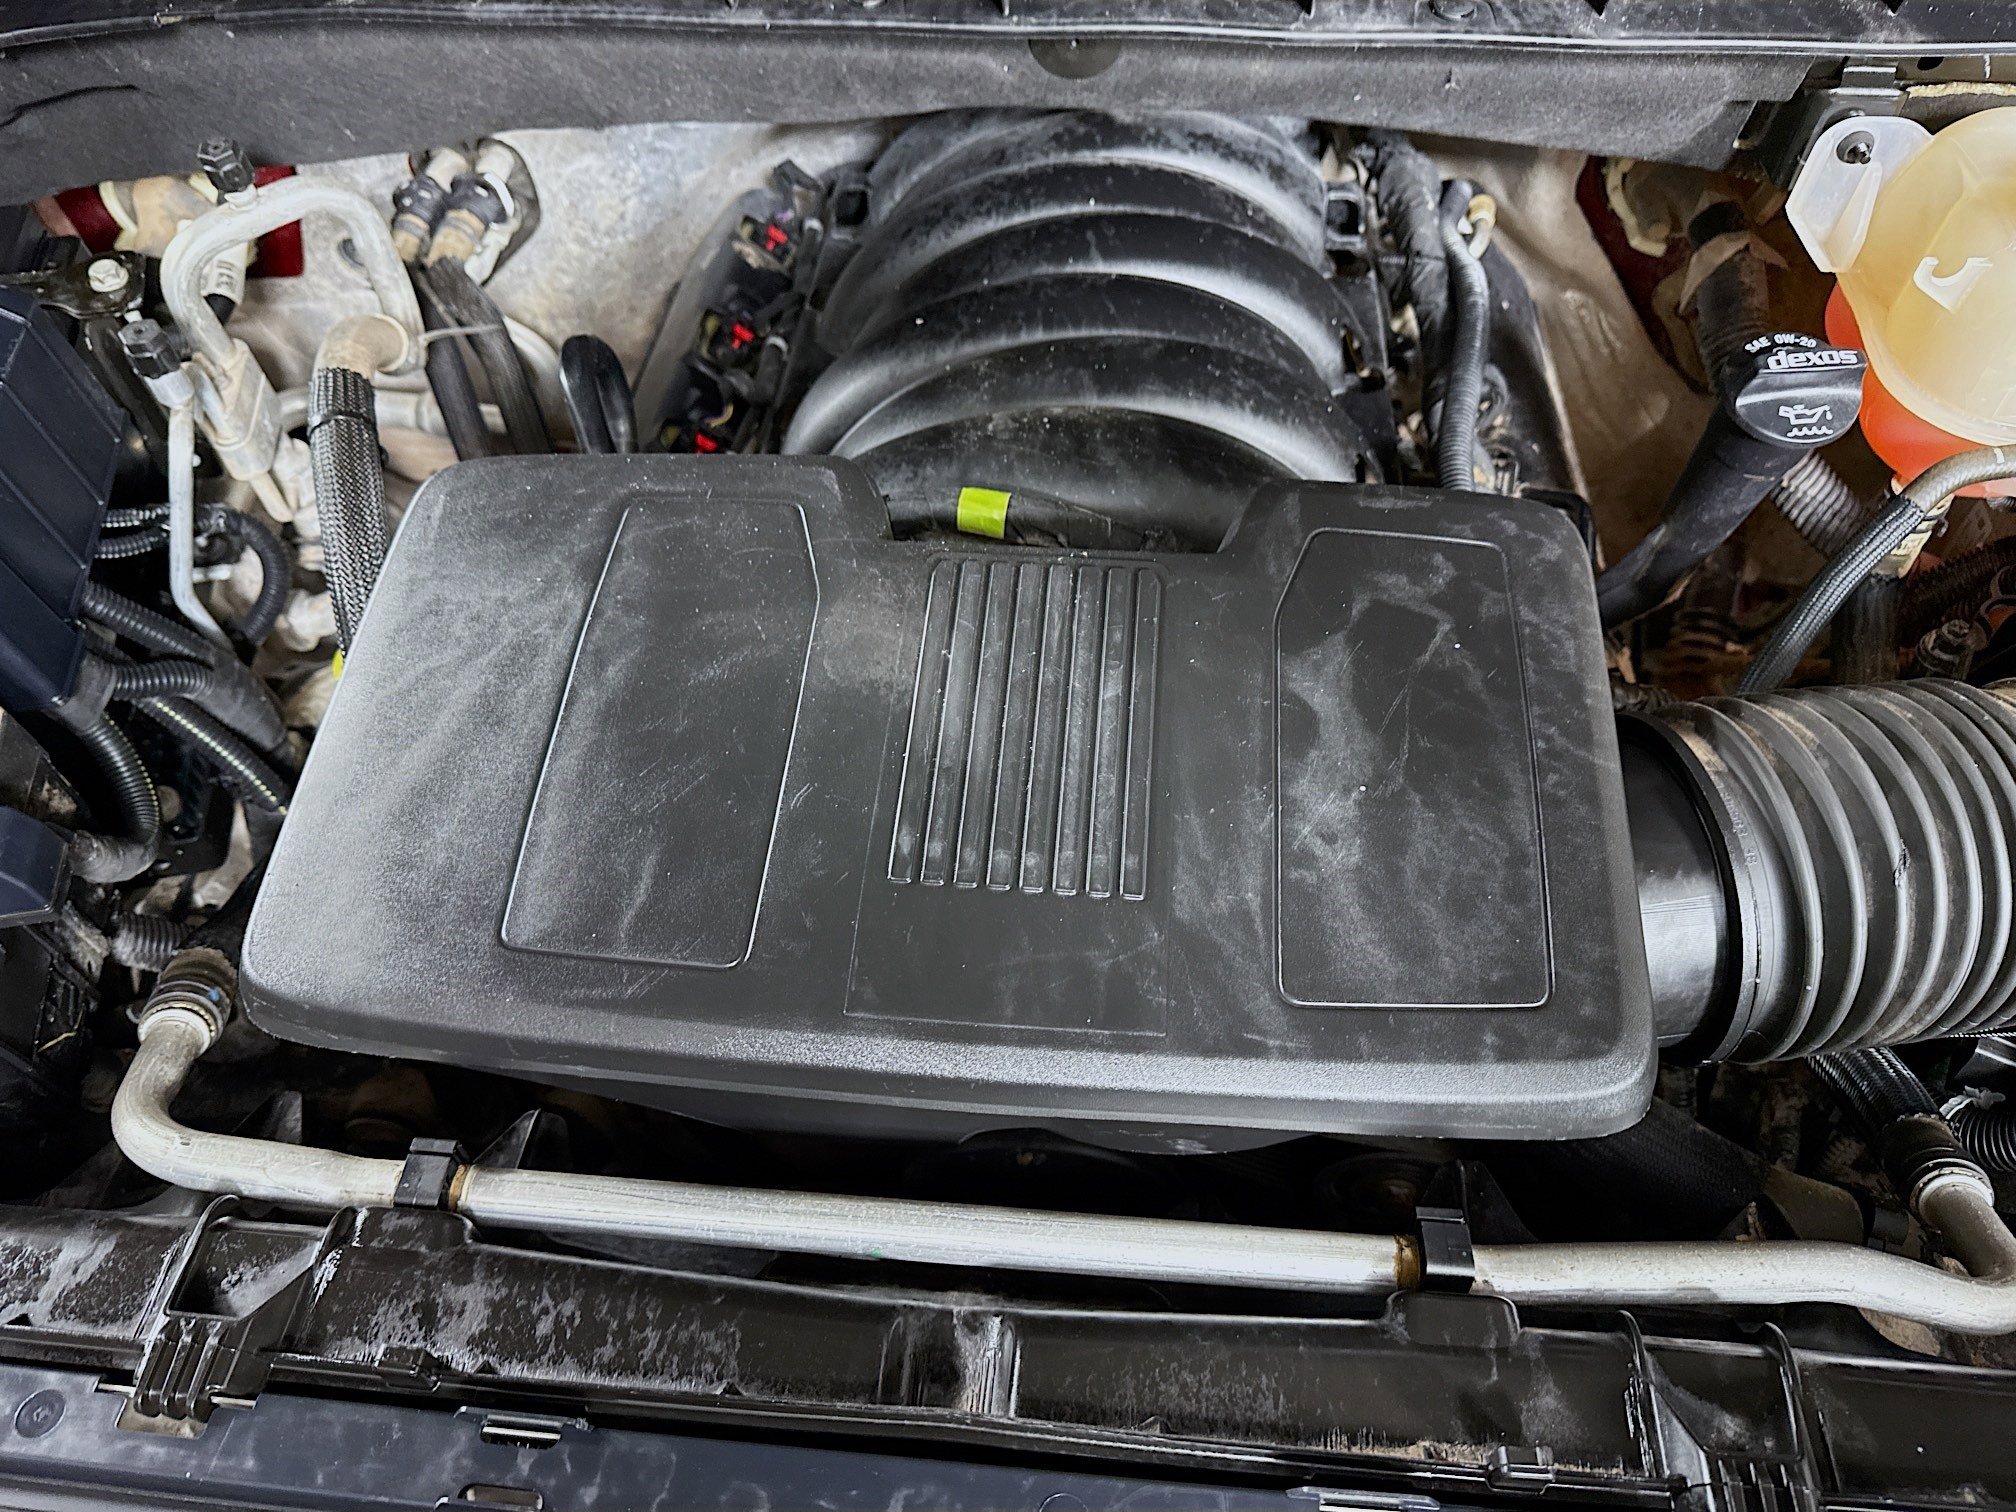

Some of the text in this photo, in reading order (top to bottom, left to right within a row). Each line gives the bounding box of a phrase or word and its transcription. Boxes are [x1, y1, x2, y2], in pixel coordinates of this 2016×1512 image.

[1744, 333, 1817, 353] SAE 0W-20
[1766, 350, 1858, 370] dexos
